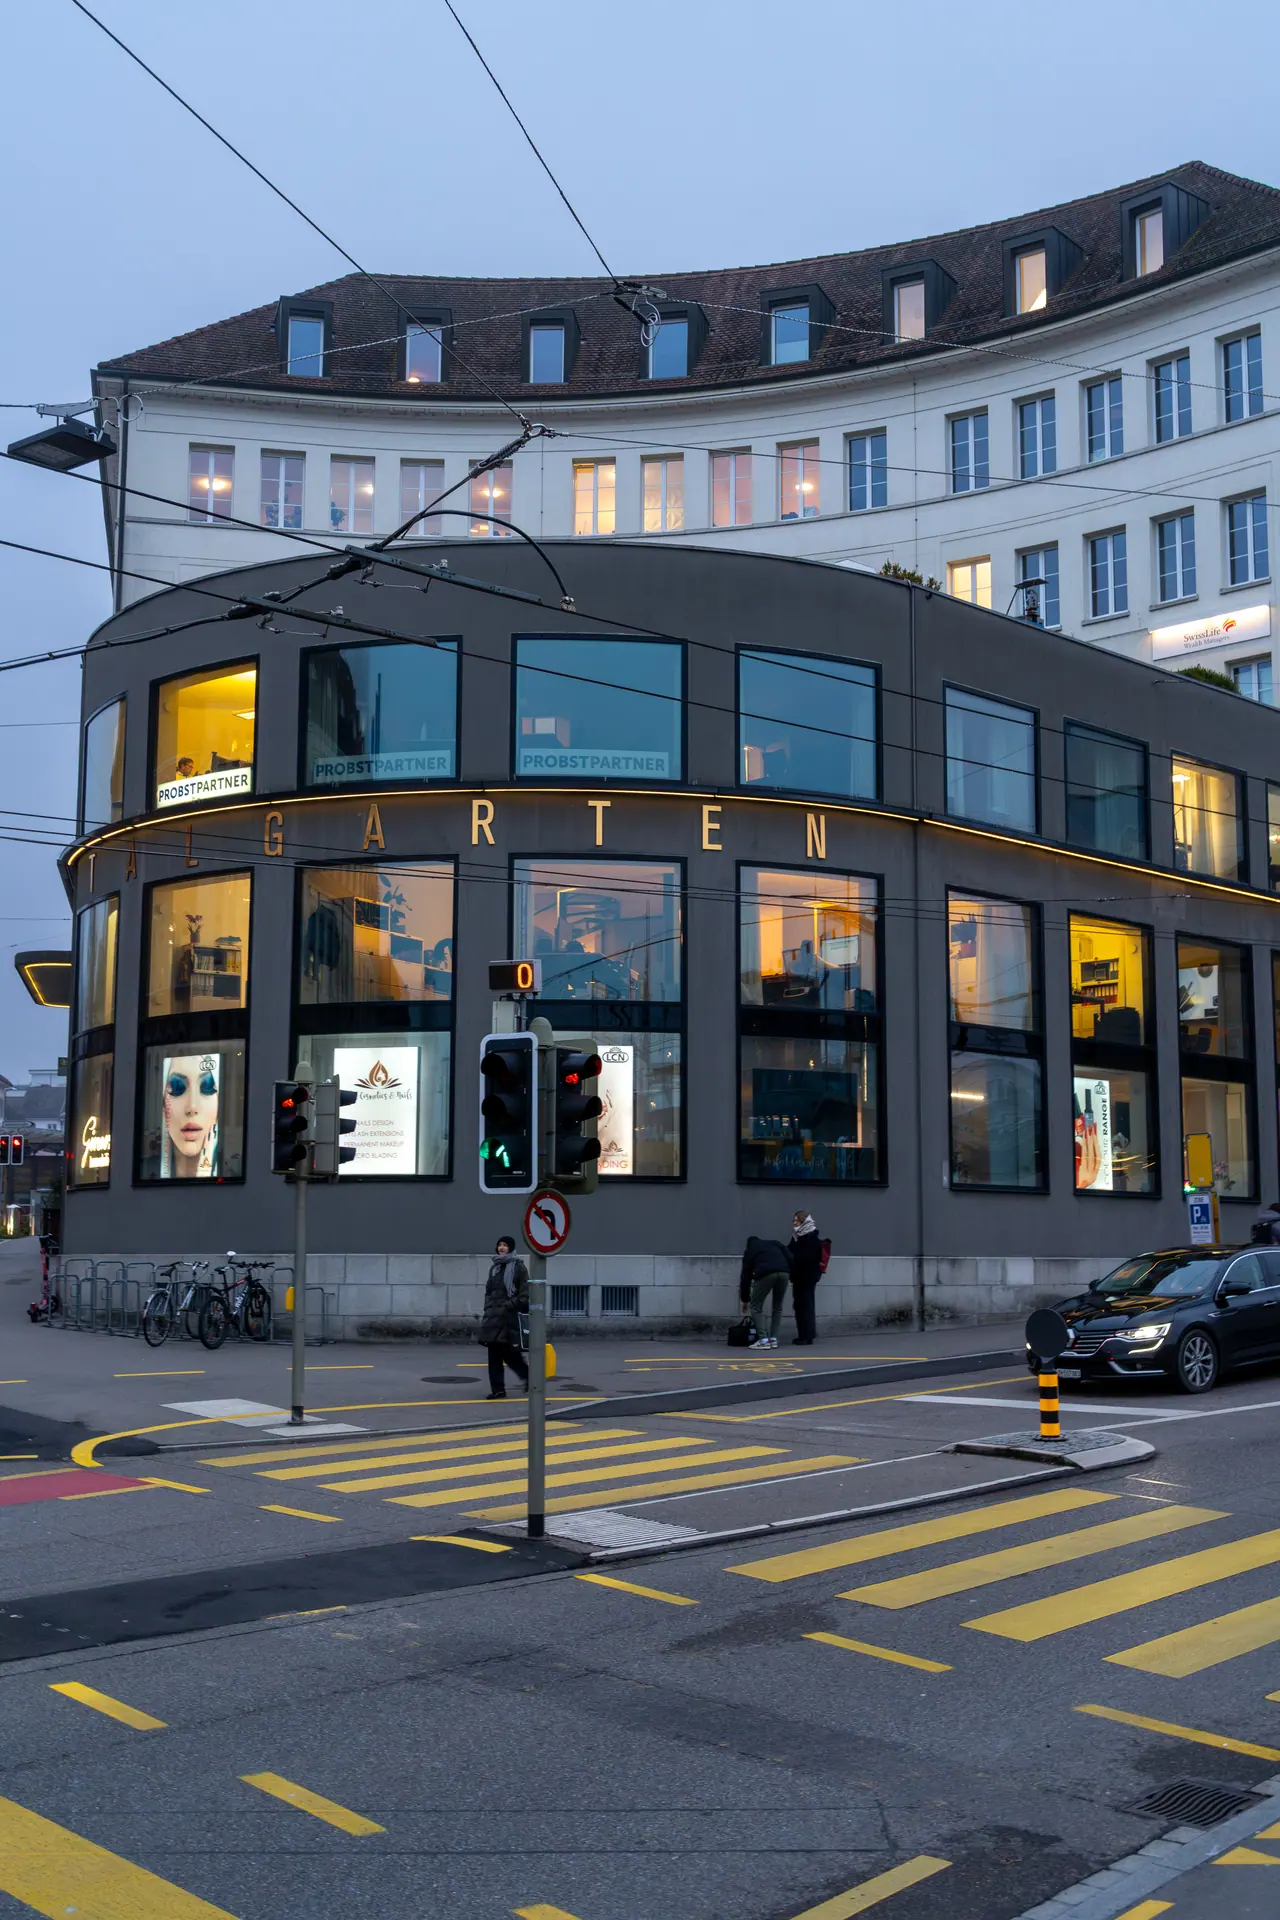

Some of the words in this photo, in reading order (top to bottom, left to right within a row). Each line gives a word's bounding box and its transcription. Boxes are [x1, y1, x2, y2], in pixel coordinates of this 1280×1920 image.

[1204, 635, 1230, 644] Managers
[316, 756, 447, 776] PROBSTPARTNER
[523, 754, 665, 772] PROBSTPARTNER
[158, 773, 249, 802] PROBSTPARTNER
[517, 963, 533, 989] 0
[605, 1053, 625, 1062] LCN
[359, 1091, 387, 1100] Cosmetics
[396, 1088, 412, 1100] Nails
[1193, 1206, 1201, 1223] P
